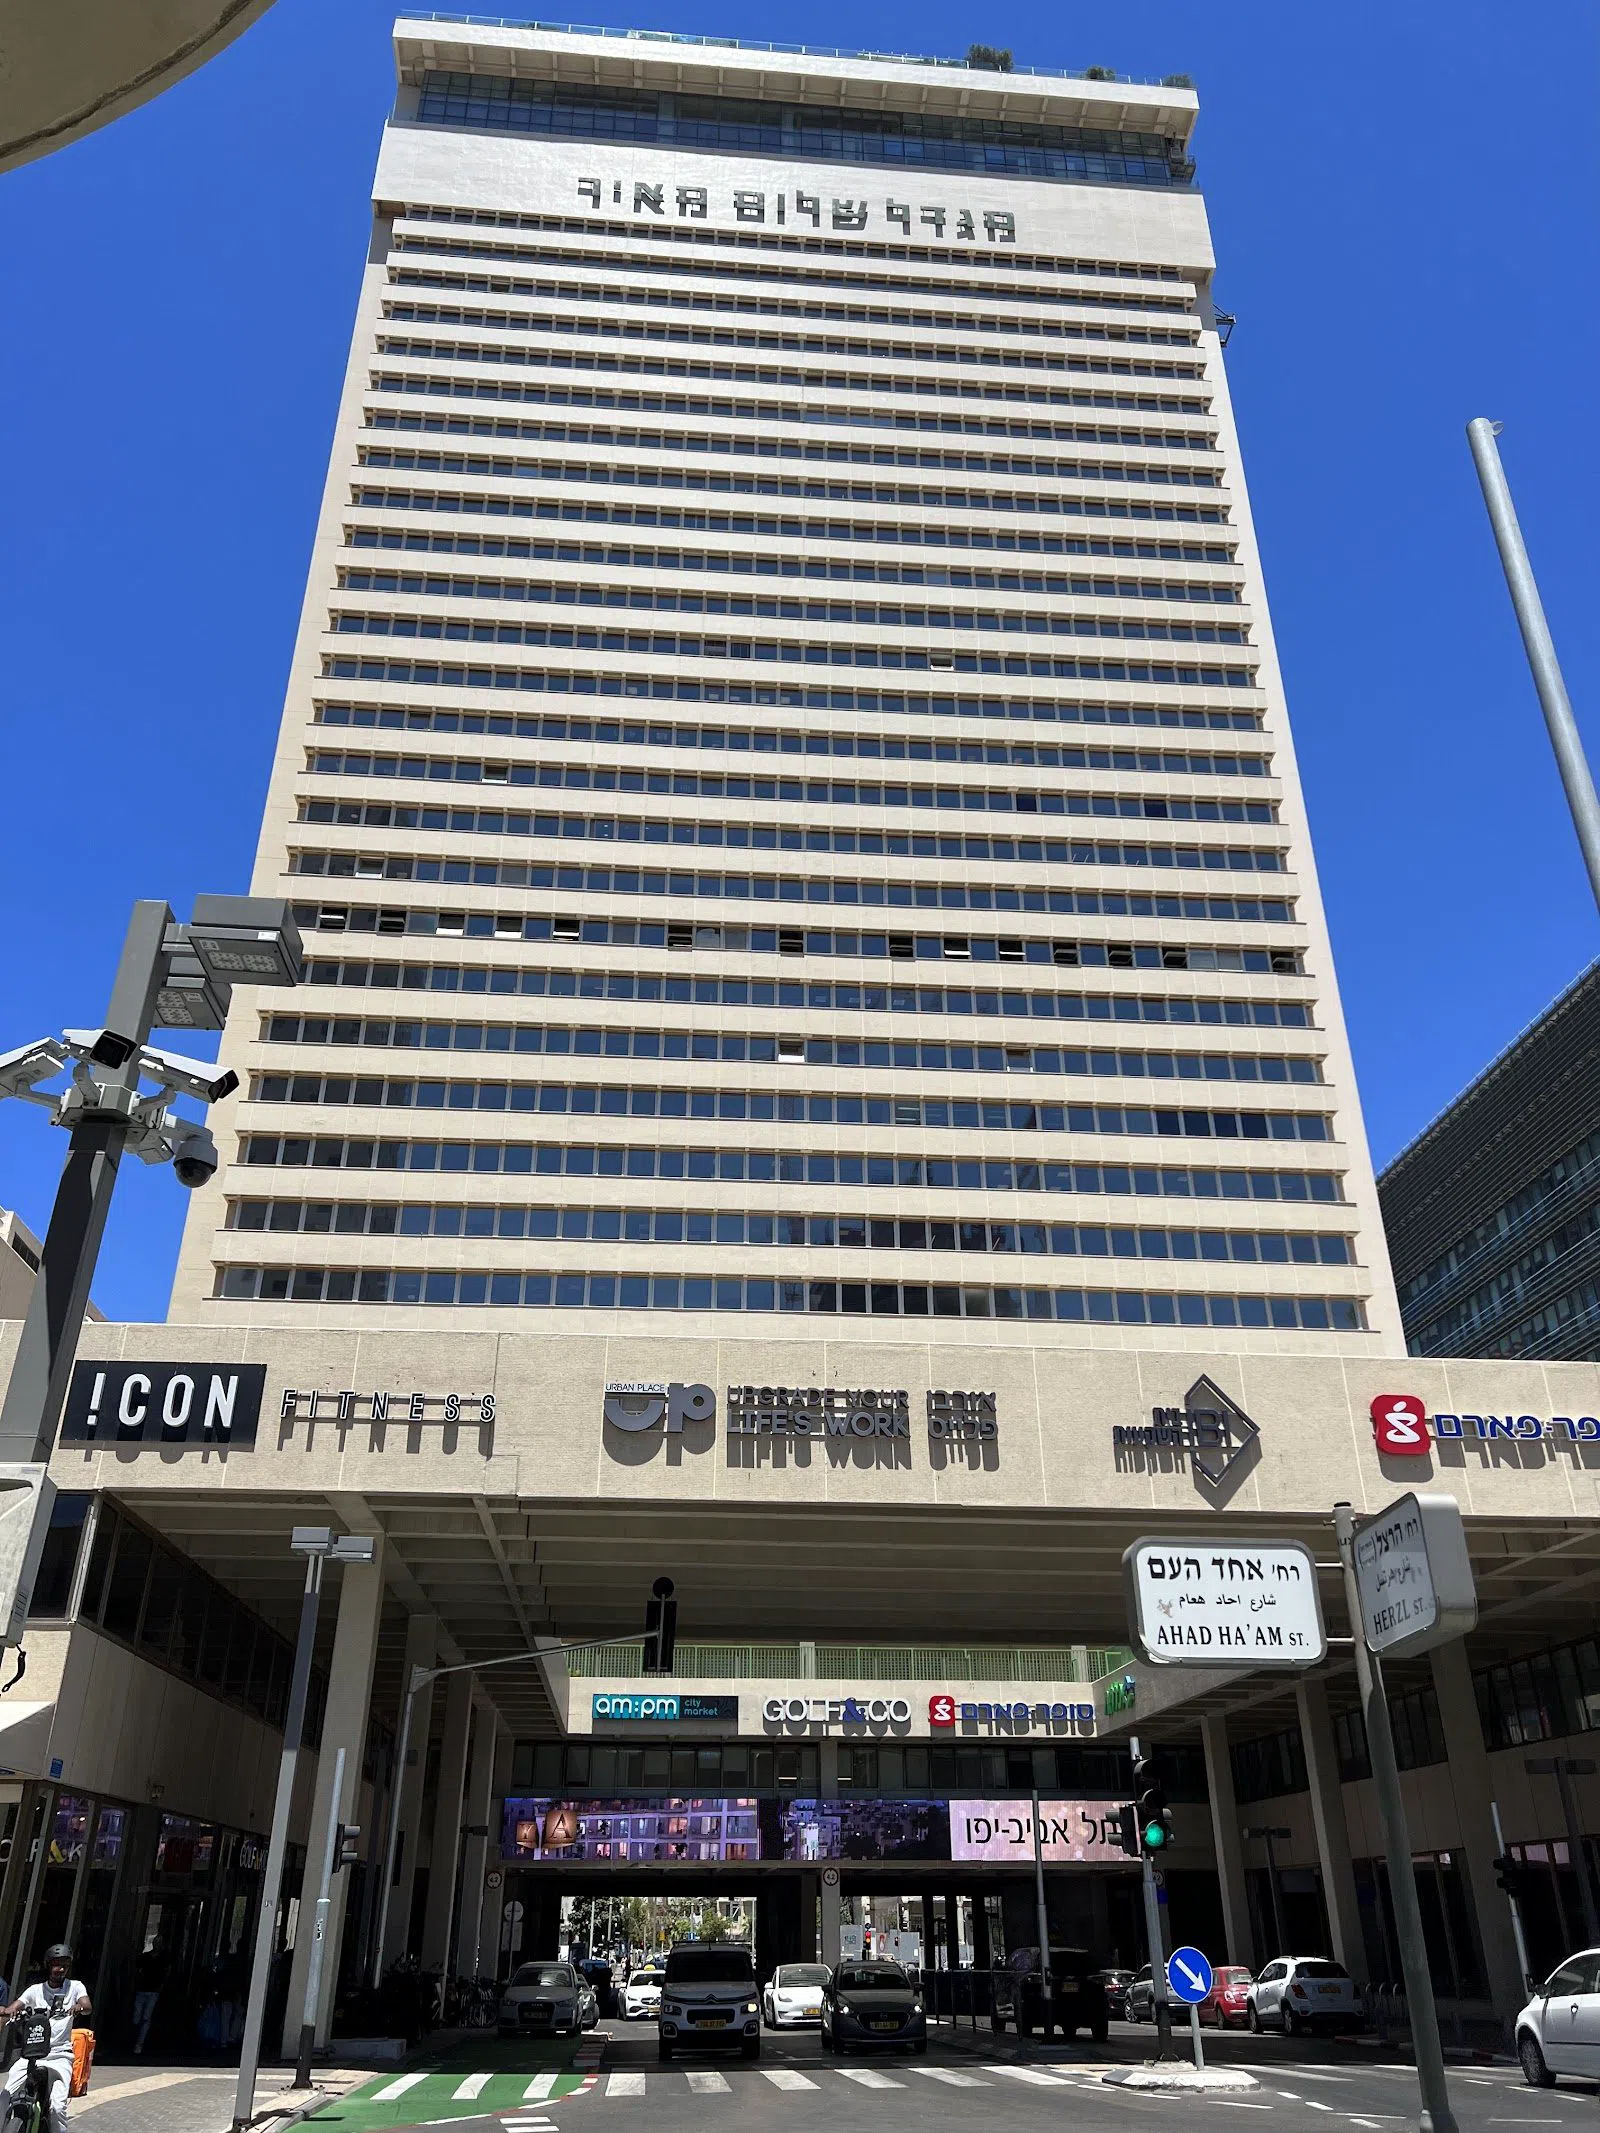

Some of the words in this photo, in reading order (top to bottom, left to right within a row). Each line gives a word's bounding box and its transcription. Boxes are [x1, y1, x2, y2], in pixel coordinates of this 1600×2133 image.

[577, 176, 707, 219] מאיר
[734, 190, 868, 231] שלום
[886, 198, 1016, 243] מגדל
[605, 1383, 634, 1391] URBAN
[637, 1384, 665, 1392] PLACE
[727, 1385, 835, 1406] UPGRADE
[846, 1388, 909, 1408] YOUR
[280, 1388, 496, 1422] FITNESS
[926, 1390, 996, 1414] אורבן
[727, 1409, 812, 1434] LIFE'S
[824, 1411, 911, 1437] WORK
[928, 1411, 998, 1440] פלייס
[1147, 1556, 1201, 1580] העם
[1211, 1557, 1264, 1581] אחד
[1272, 1564, 1300, 1581] רח'
[1179, 1593, 1206, 1608] هعام
[1216, 1594, 1241, 1605] احاد
[1250, 1594, 1276, 1611] شارع
[1374, 1598, 1411, 1635] HERZL
[1157, 1625, 1212, 1645] AHAD
[1218, 1624, 1283, 1646] HA'AM
[1289, 1632, 1309, 1646] ST.
[596, 1698, 677, 1718] am:pm
[684, 1699, 701, 1708] city
[684, 1707, 718, 1716] market
[961, 1702, 1094, 1721] סופר-פארם
[965, 1817, 1070, 1844] אביב-יפו
